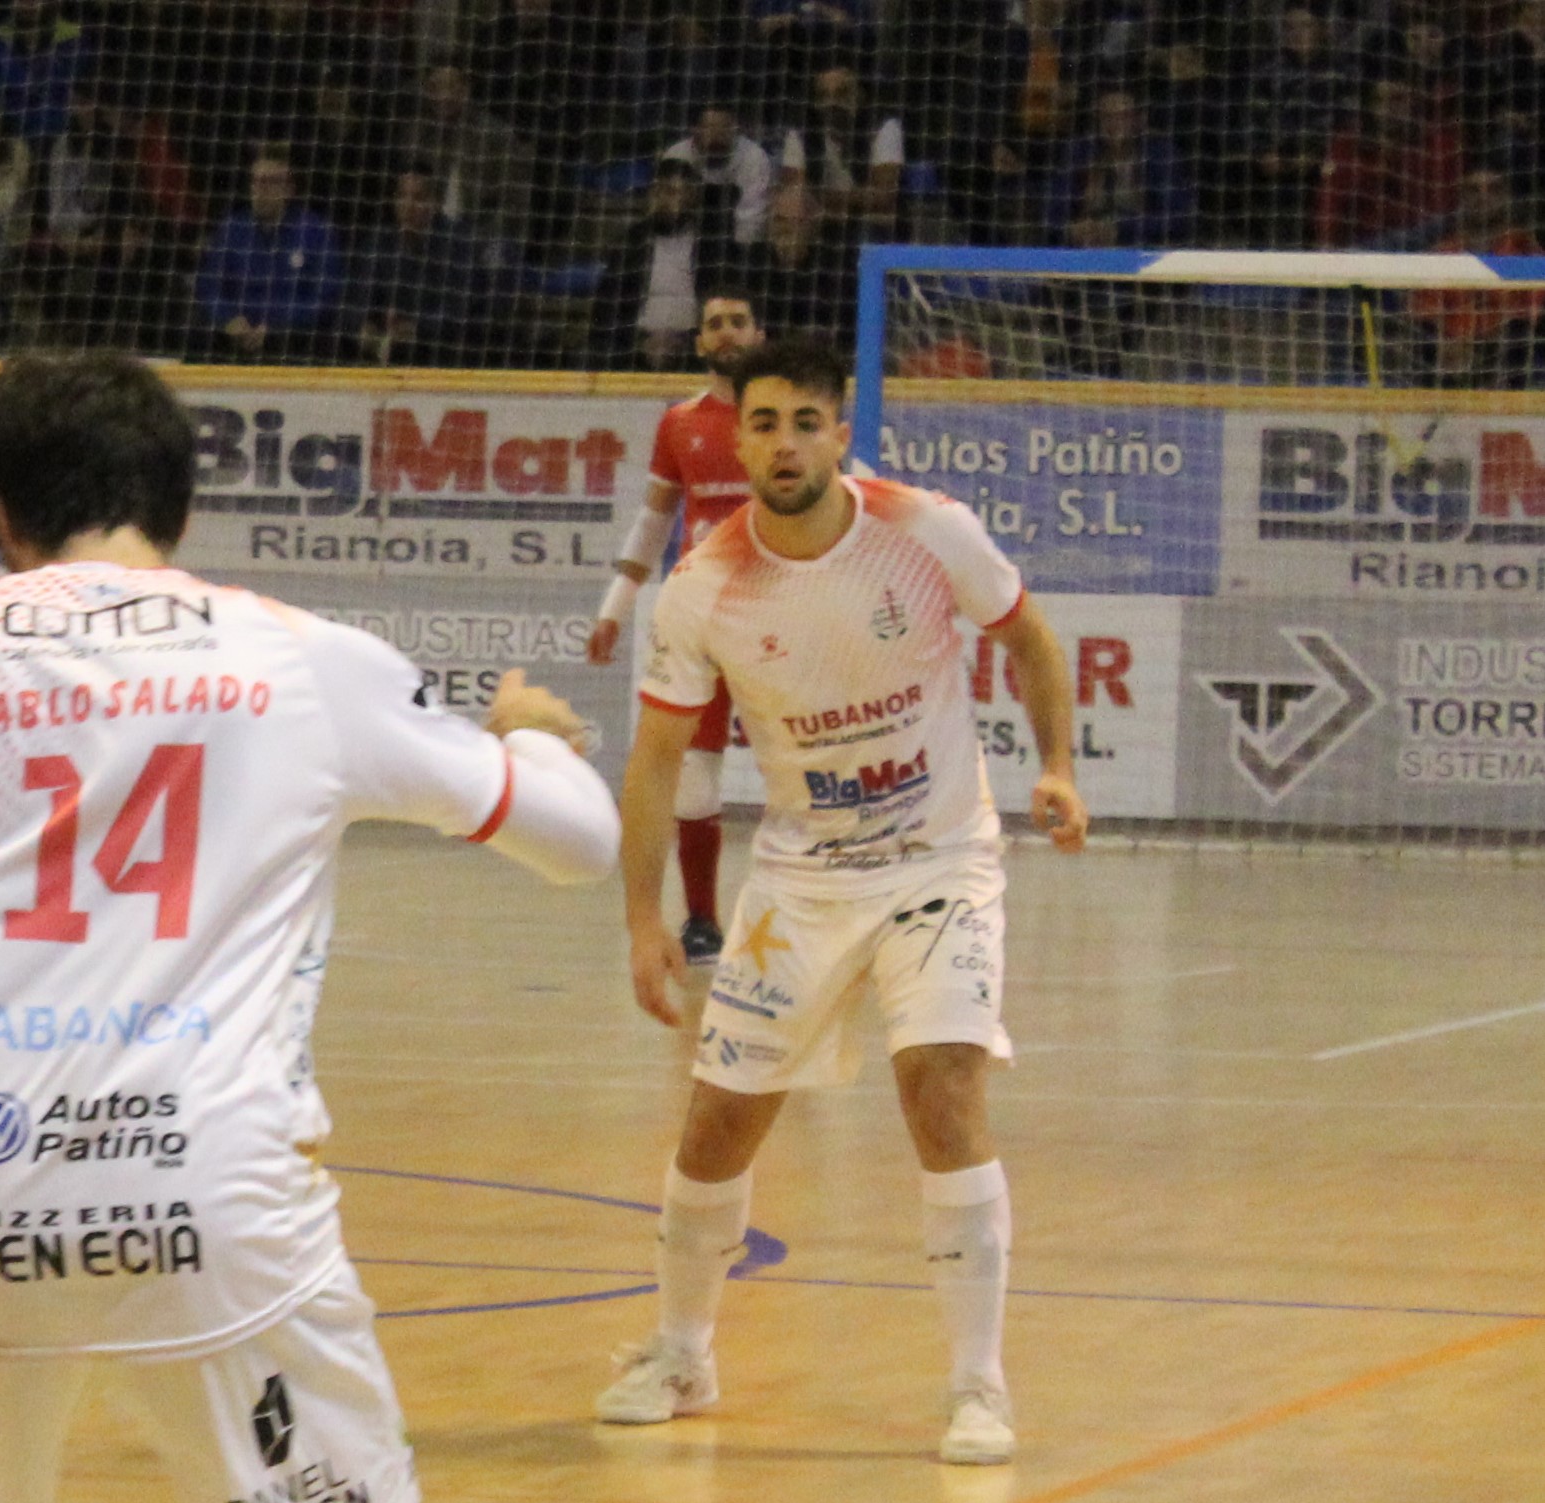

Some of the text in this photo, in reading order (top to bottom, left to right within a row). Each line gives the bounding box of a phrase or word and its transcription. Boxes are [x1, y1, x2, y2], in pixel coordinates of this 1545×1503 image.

[193, 405, 627, 517] BigMat
[880, 427, 1182, 476] Autos Patiño
[1260, 428, 1545, 542] BigM
[978, 487, 1143, 543] ia, S.L.
[251, 525, 616, 571] Rianoia, S.L.
[1351, 551, 1545, 591] Rianoi
[322, 611, 587, 661] DUSTRIAS
[105, 673, 272, 719] SALADO
[782, 684, 922, 736] TUBANOR
[1404, 697, 1545, 739] TORR
[804, 746, 929, 806] BigMat
[1404, 751, 1545, 781] SISTEMA
[3, 743, 205, 944] 14
[38, 1090, 180, 1125] Autos
[31, 1126, 189, 1164] Patiño
